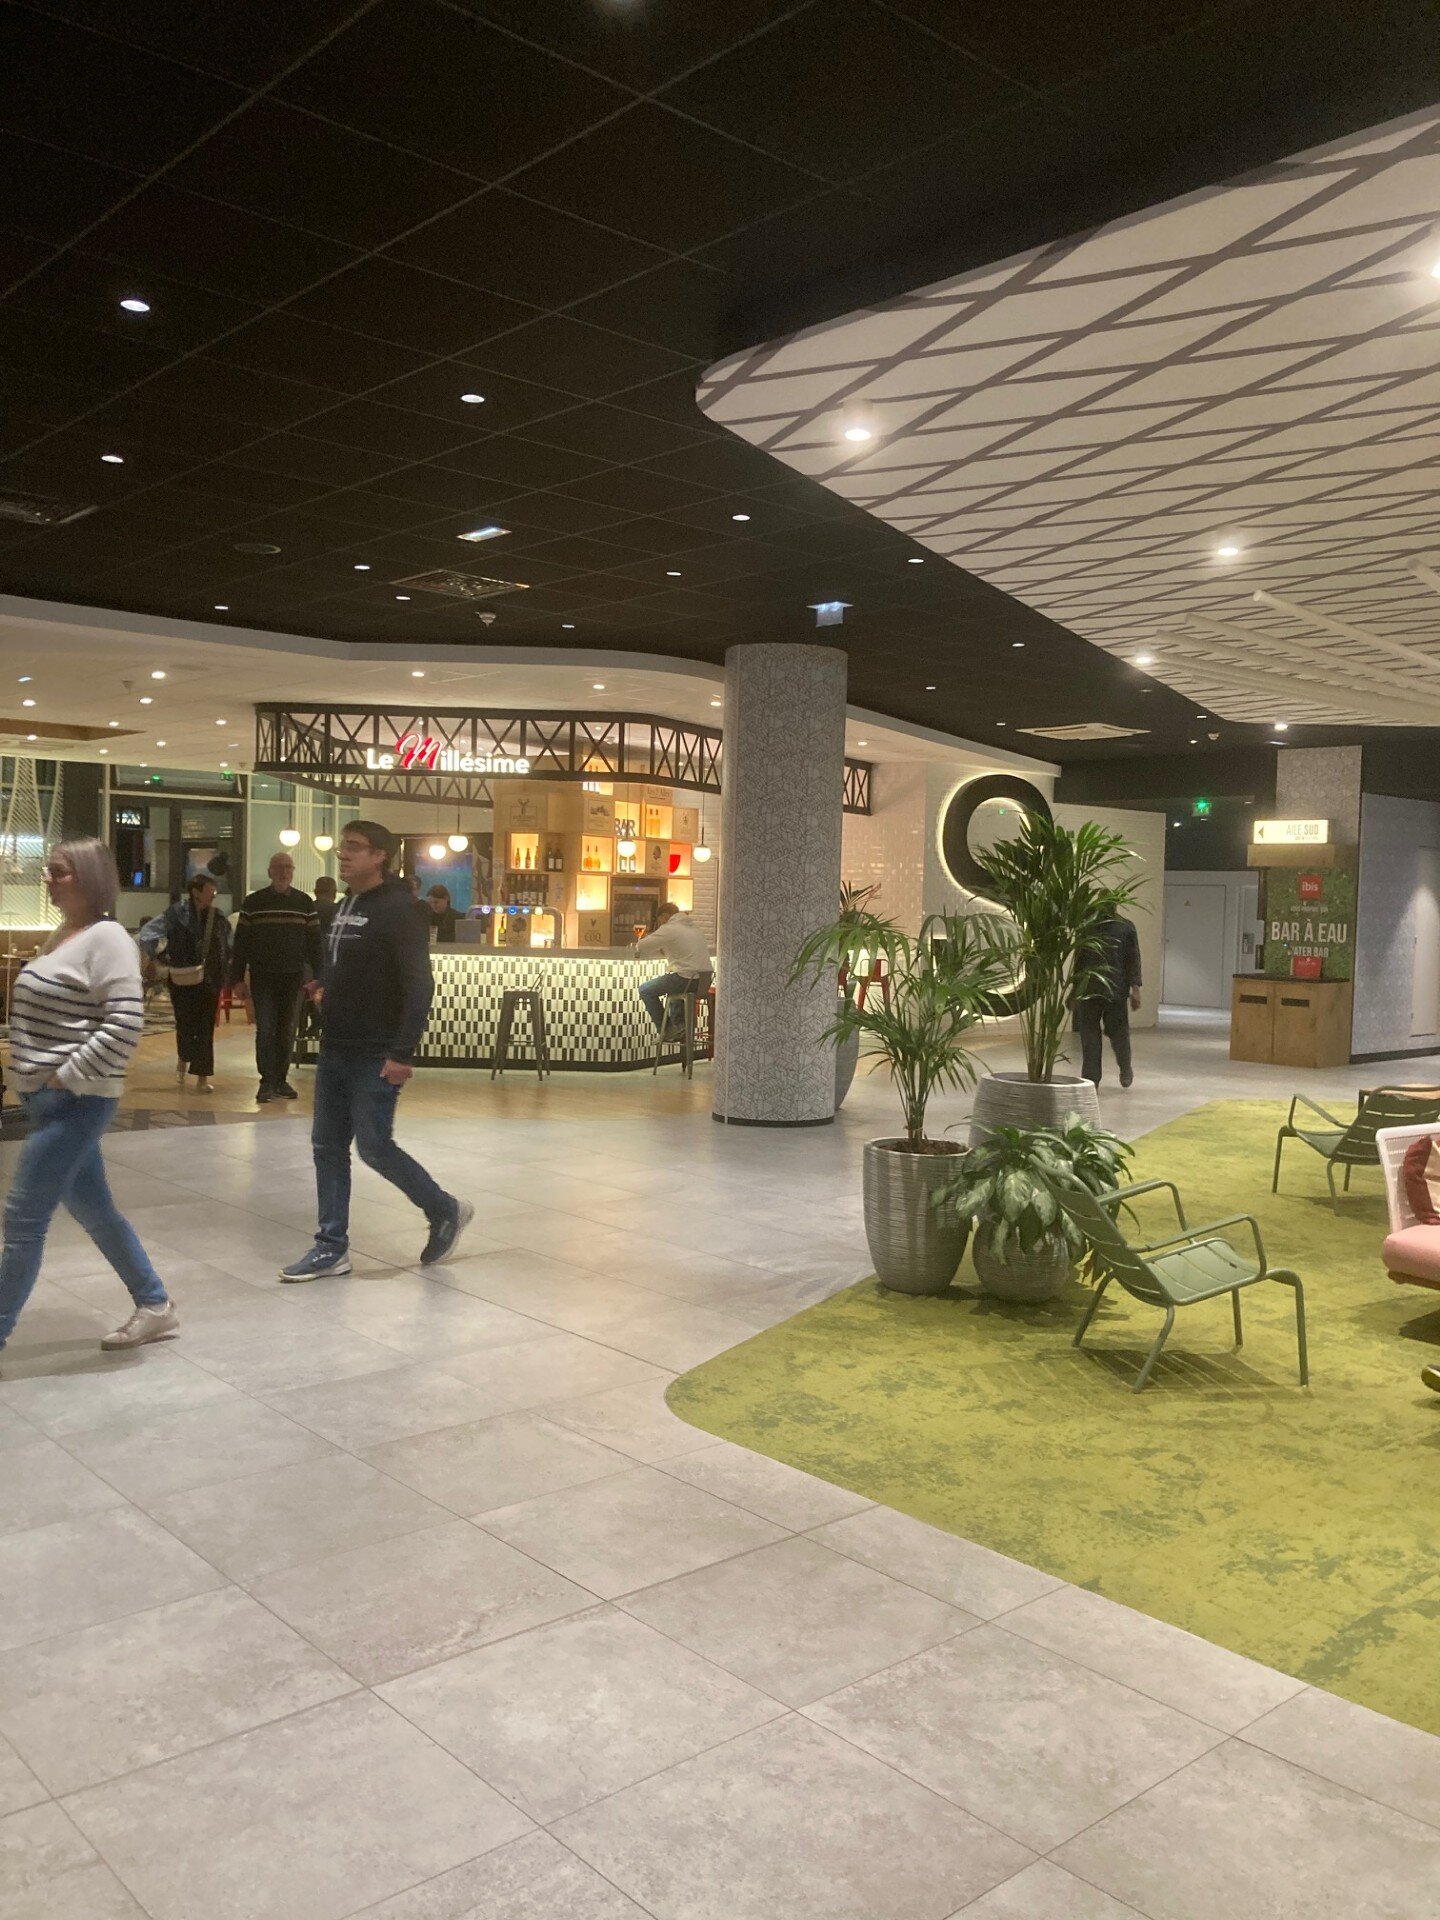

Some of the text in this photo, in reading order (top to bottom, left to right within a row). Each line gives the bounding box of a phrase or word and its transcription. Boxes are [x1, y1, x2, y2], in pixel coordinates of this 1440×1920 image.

[366, 732, 530, 774] Le Millésime
[614, 817, 636, 838] BAR
[1303, 824, 1319, 835] SUD
[1302, 881, 1319, 892] ibis
[1271, 918, 1347, 944] BAR À EAU
[1313, 947, 1329, 958] BAR
